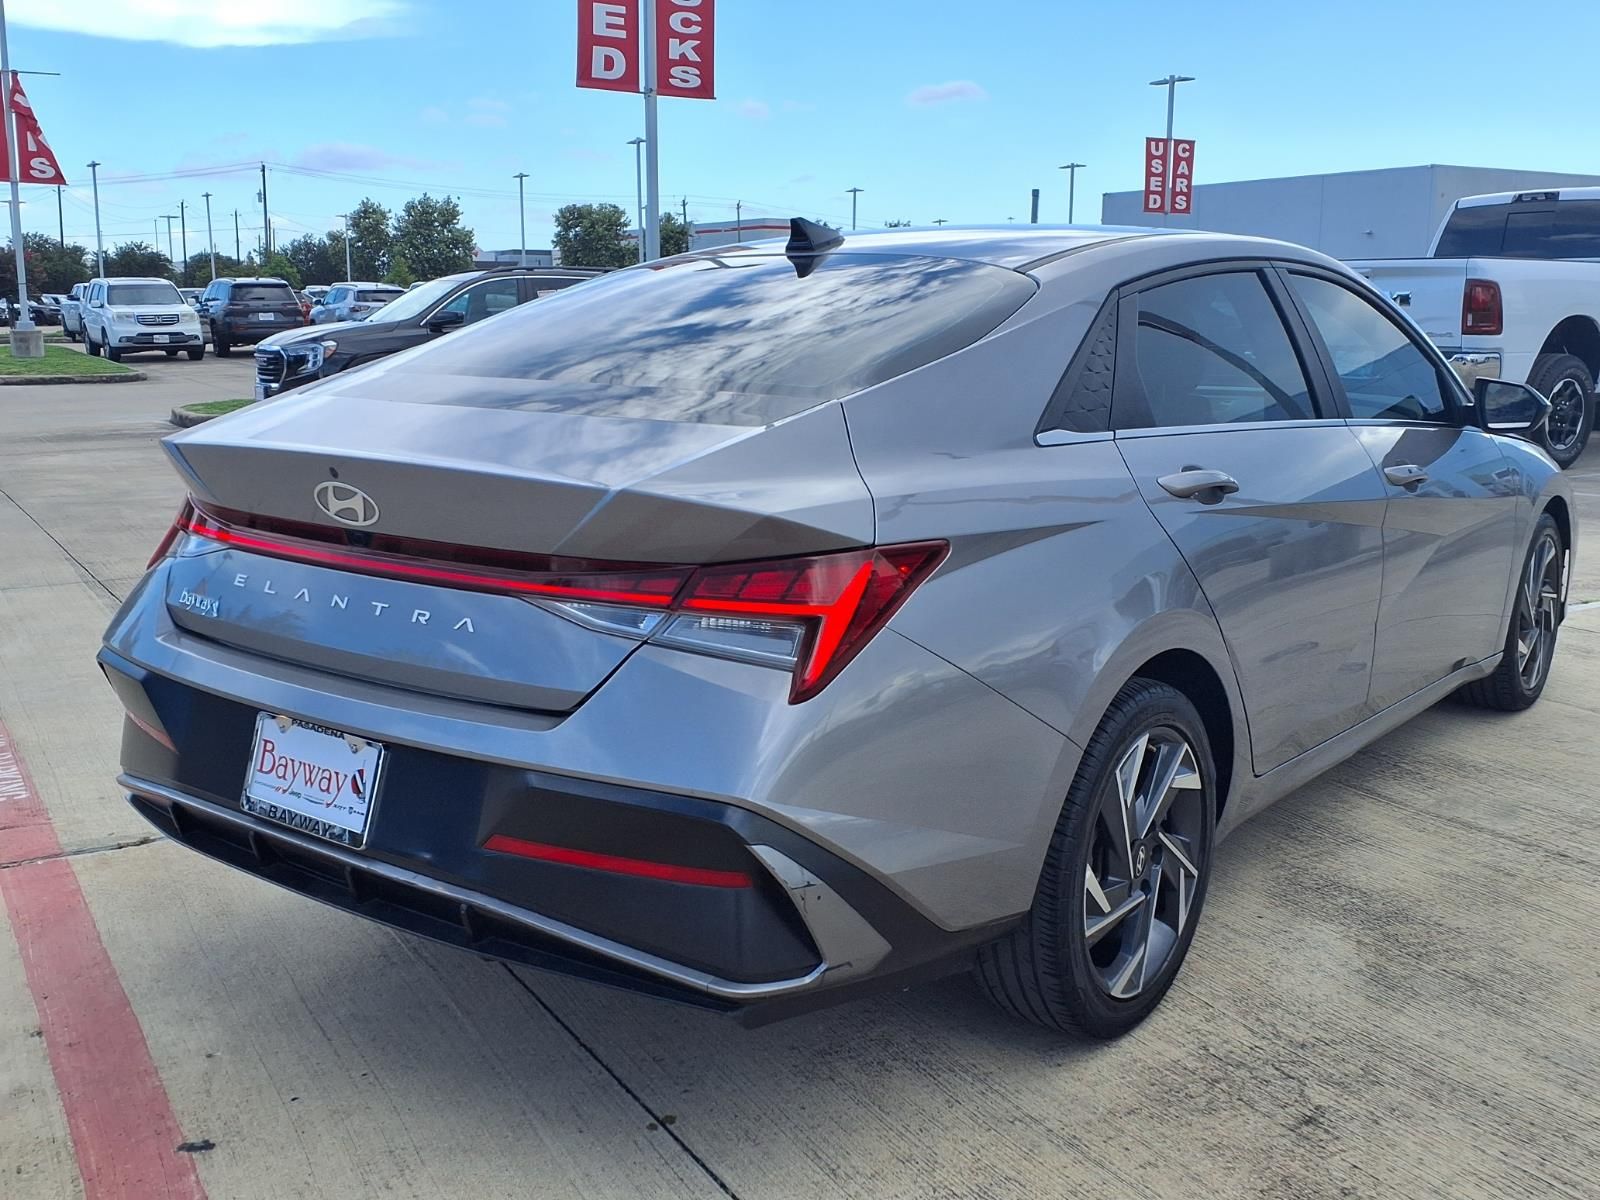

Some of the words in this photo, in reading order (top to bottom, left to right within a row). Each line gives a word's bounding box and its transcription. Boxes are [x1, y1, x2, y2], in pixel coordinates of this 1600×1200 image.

[1148, 141, 1164, 209] USED
[1174, 143, 1190, 210] CARS
[233, 573, 475, 633] ELANTRA
[291, 718, 345, 740] PASADENA
[257, 738, 348, 808] Bayway
[268, 804, 332, 838] BAYWAY
